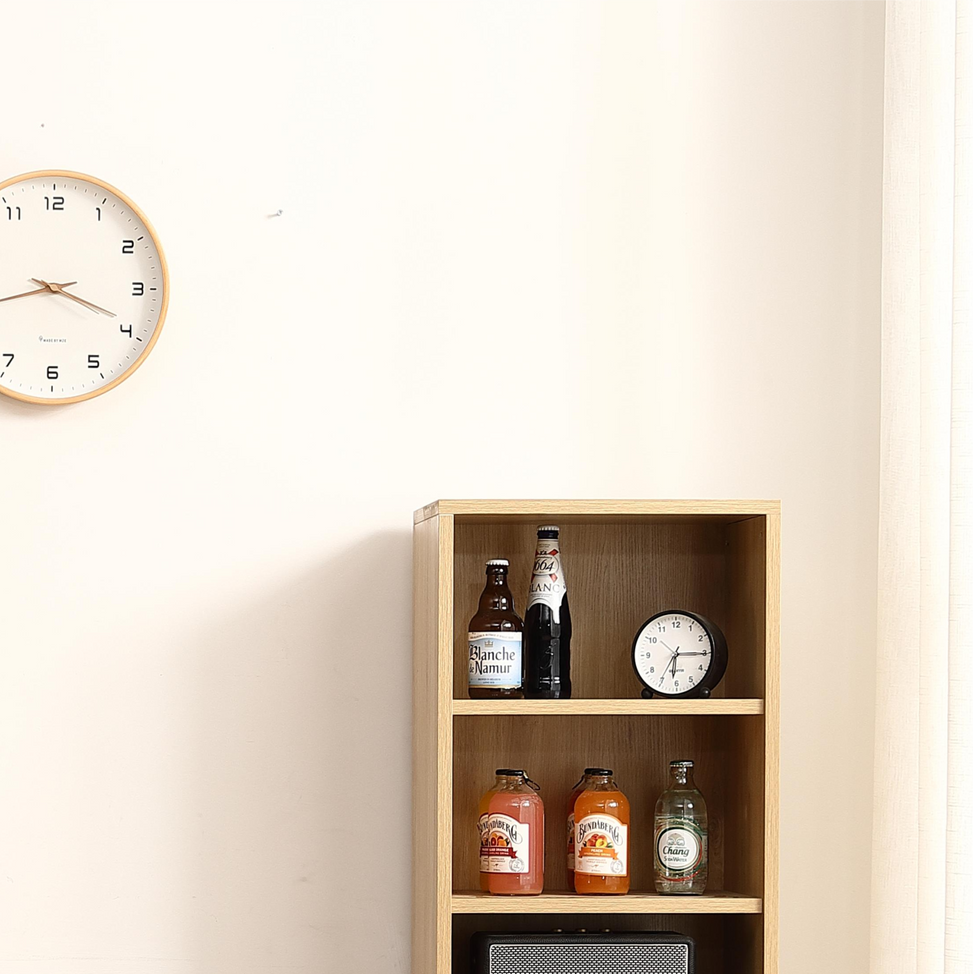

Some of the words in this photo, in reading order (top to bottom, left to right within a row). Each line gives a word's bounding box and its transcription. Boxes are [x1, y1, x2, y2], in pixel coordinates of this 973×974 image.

[43, 196, 65, 211] 12
[6, 206, 21, 221] 11
[95, 207, 101, 221] 1
[122, 239, 134, 254] 2
[131, 282, 144, 296] 3
[119, 324, 132, 338] 4
[2, 353, 14, 367] 7
[87, 354, 100, 369] 5
[46, 365, 59, 380] 6
[534, 558, 554, 572] 664
[529, 583, 560, 593] LANC
[469, 644, 516, 661] Blanche
[474, 659, 512, 676] Namur
[577, 819, 624, 847] BUNDABERG
[662, 845, 690, 858] Chang
